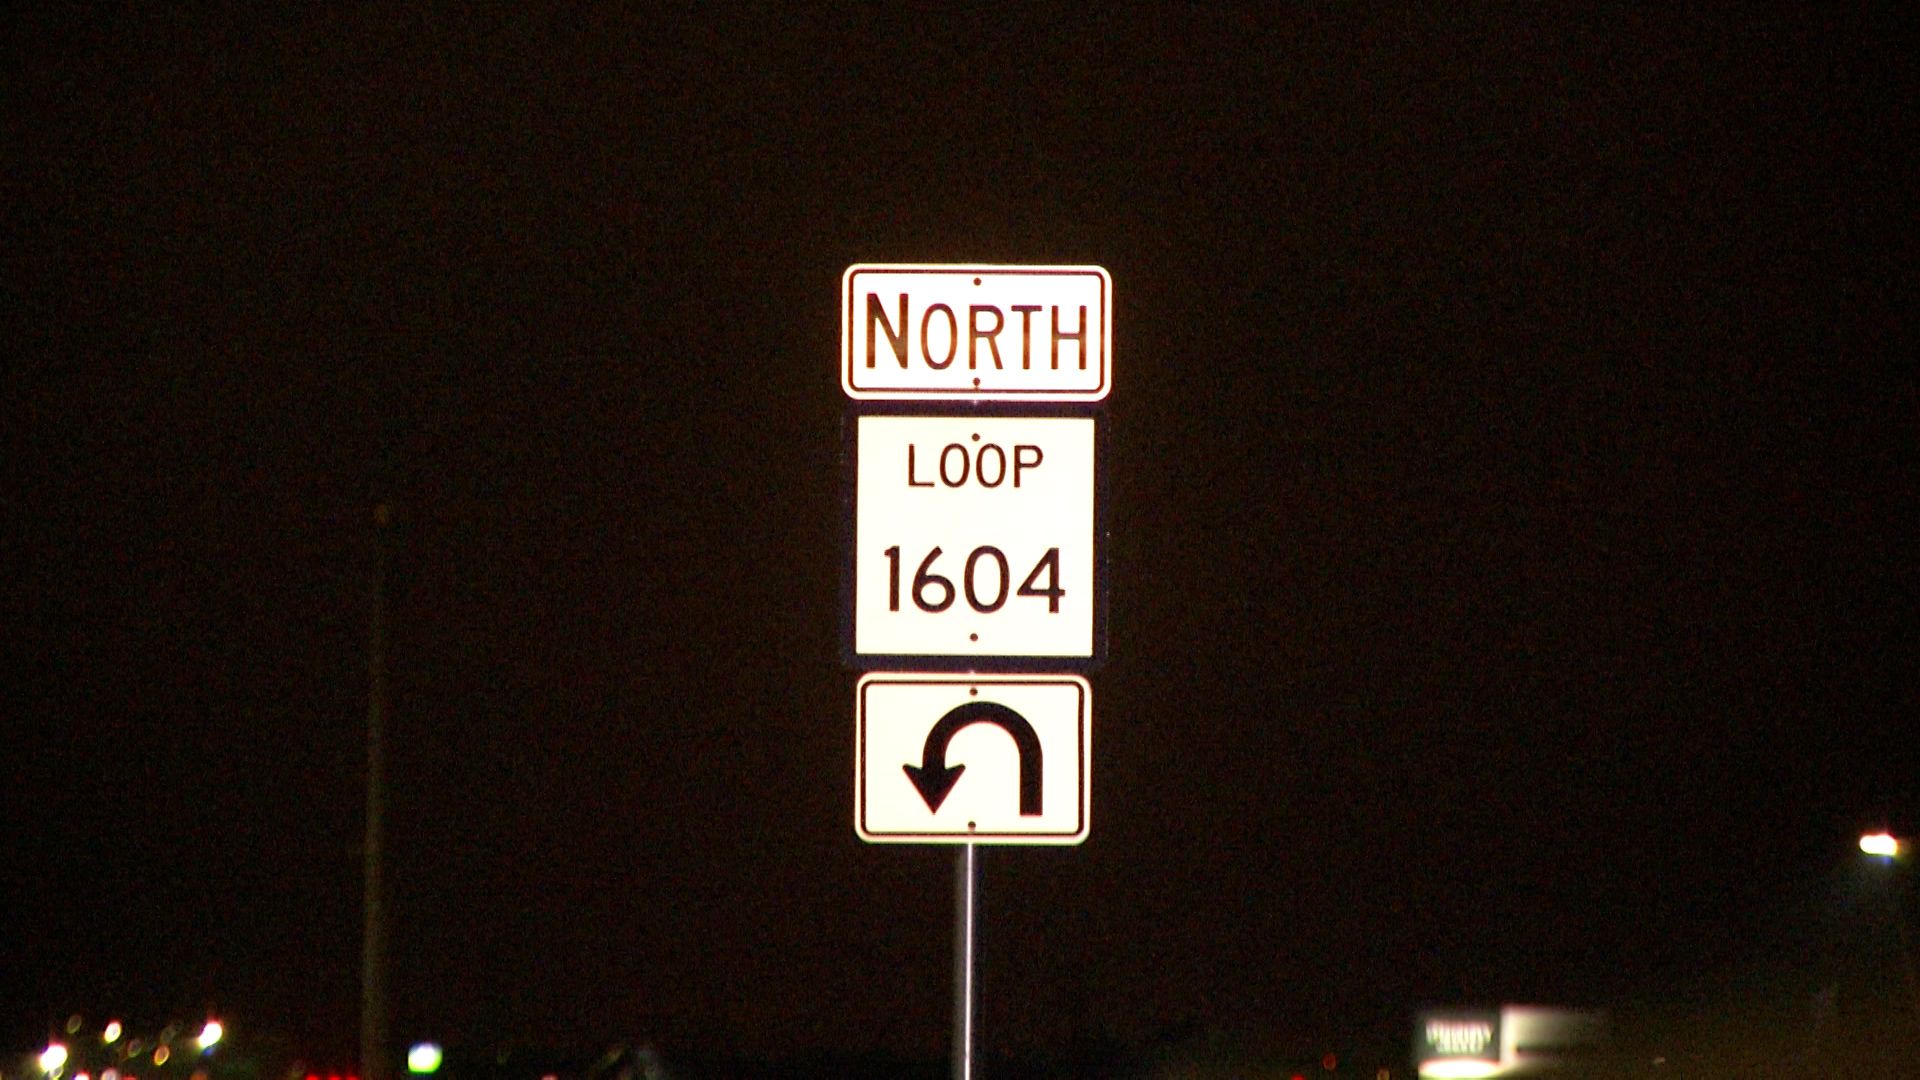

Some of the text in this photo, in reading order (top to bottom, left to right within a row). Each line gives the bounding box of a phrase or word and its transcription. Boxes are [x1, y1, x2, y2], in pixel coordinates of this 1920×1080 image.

[866, 292, 1087, 370] NORTH
[908, 443, 1044, 488] LOOP
[884, 545, 1066, 614] 1604
